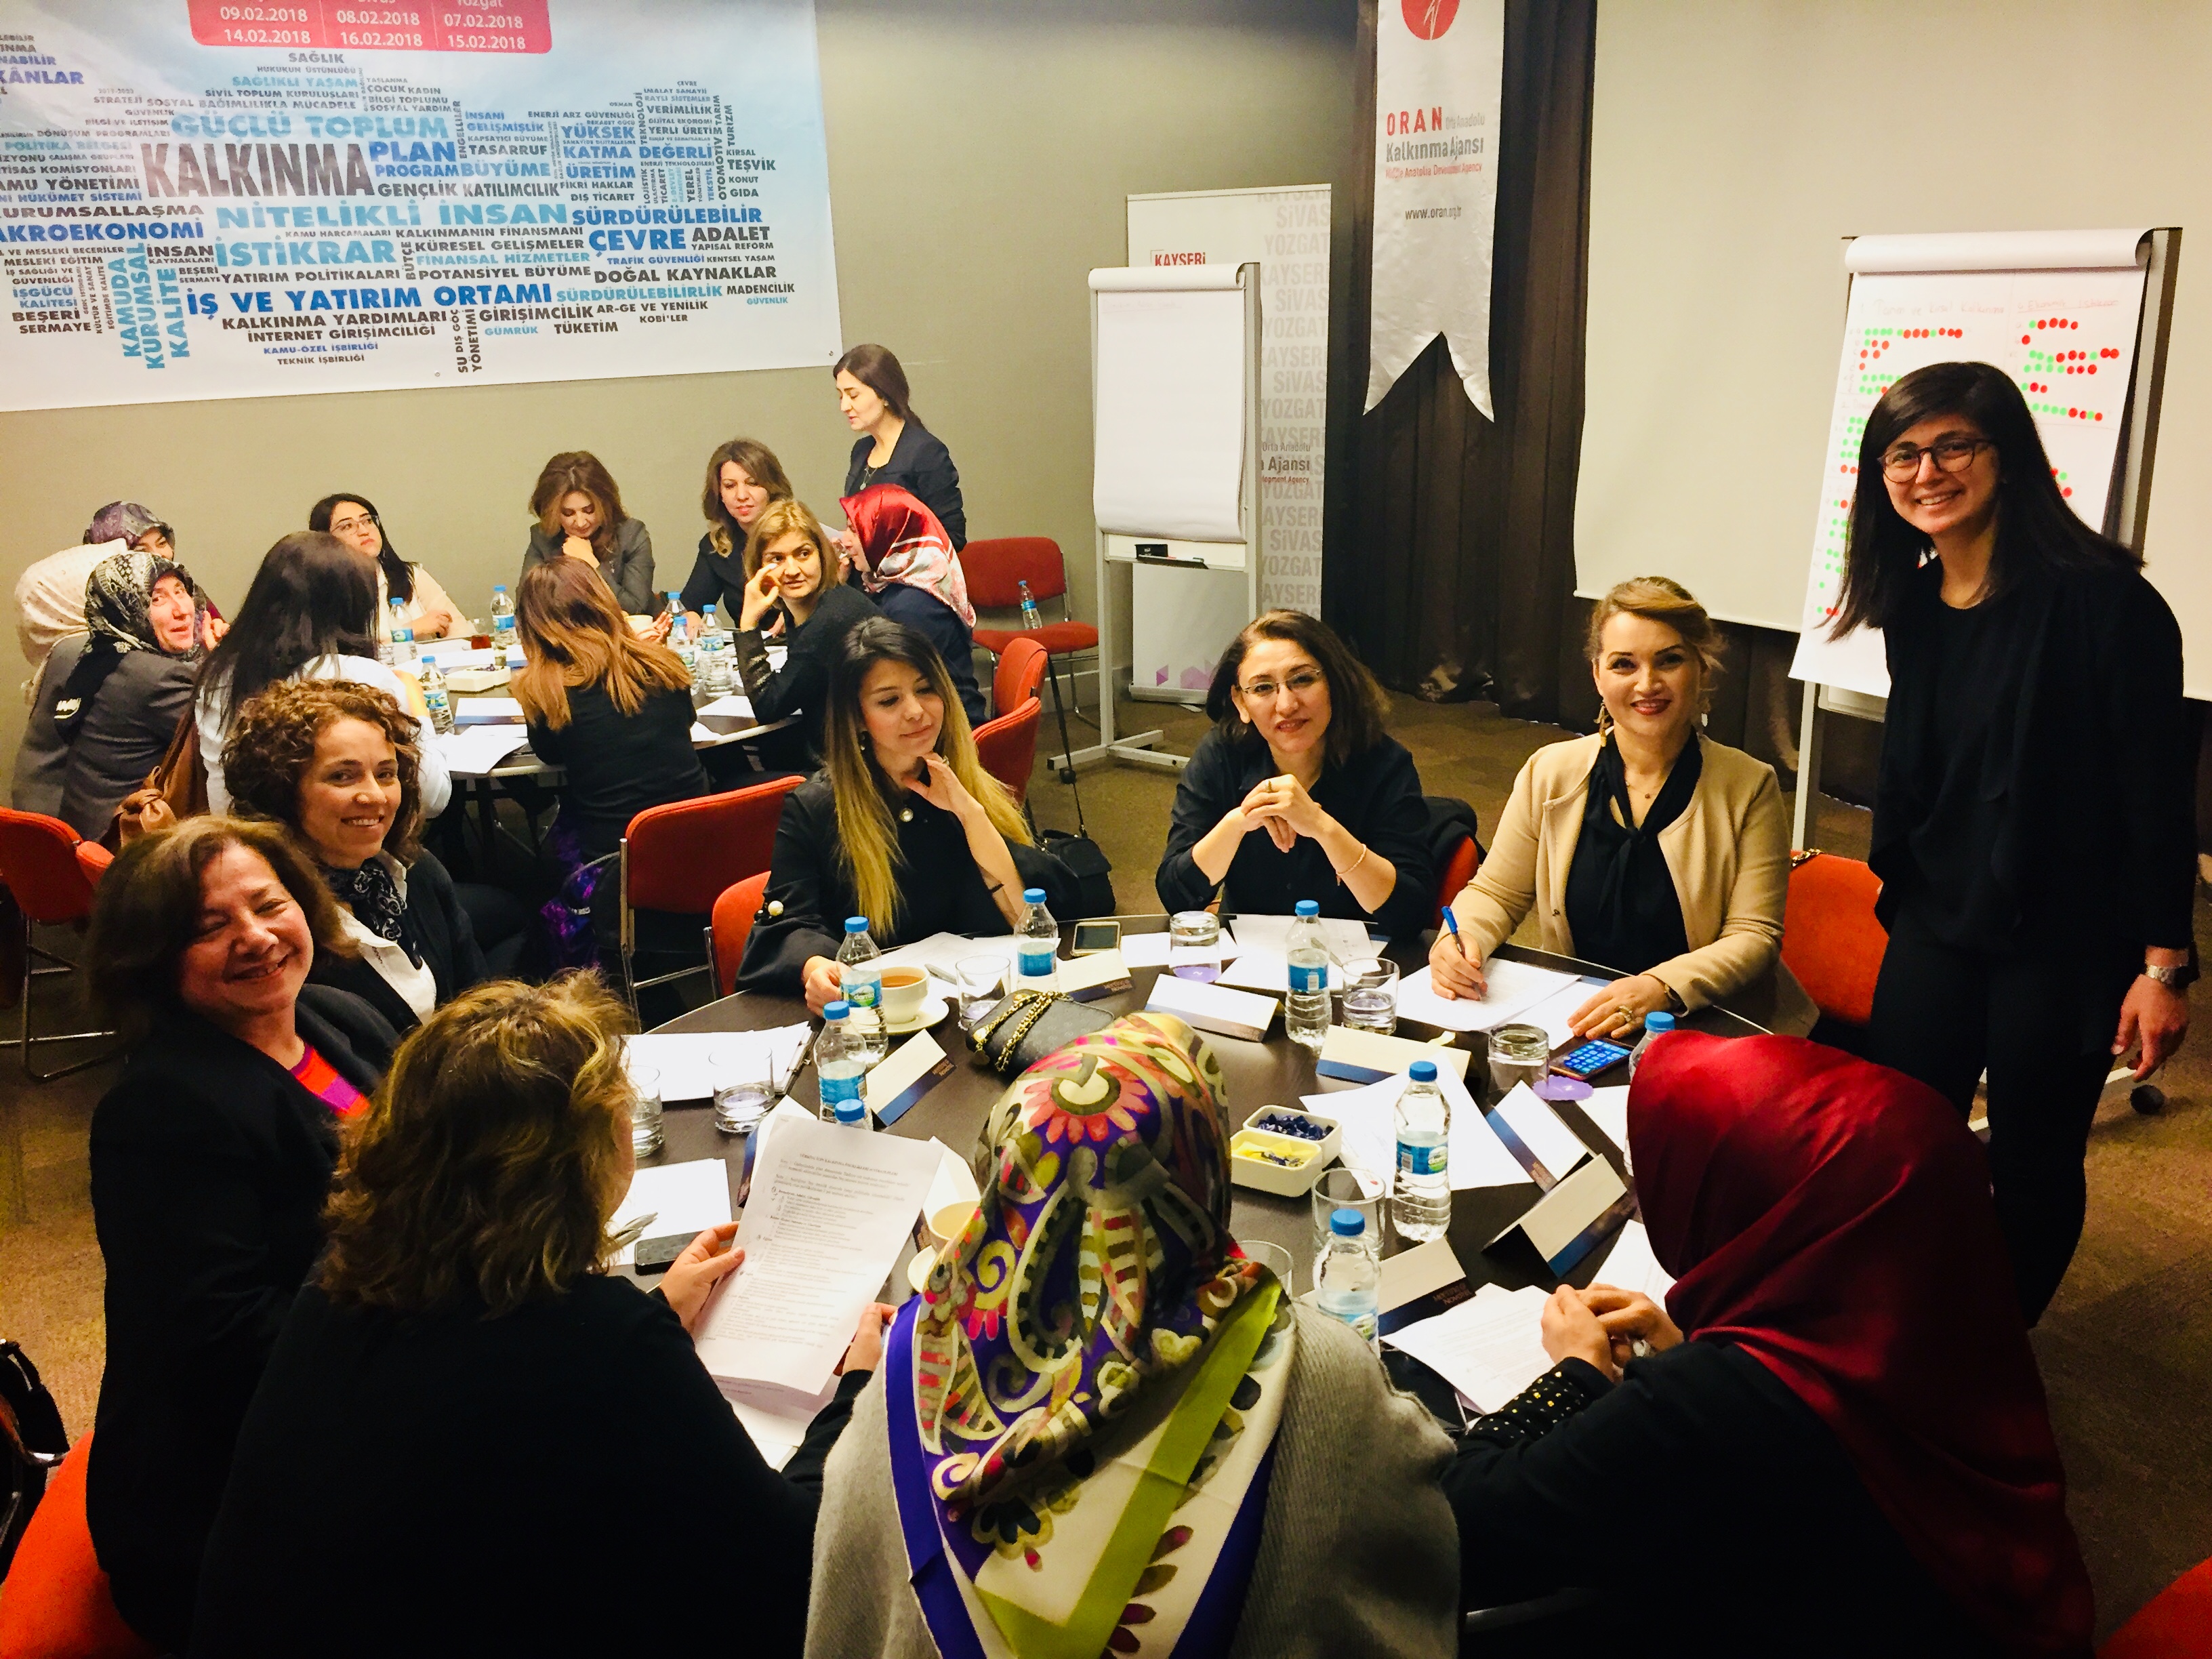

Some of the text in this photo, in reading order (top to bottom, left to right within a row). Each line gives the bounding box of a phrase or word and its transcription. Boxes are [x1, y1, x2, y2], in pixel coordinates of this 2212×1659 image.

[220, 7, 523, 28] 09.02.2018 08.02.2018 07.02.2018
[224, 28, 526, 49] 14.02.2018 16.02.2018 15.02.2018
[289, 51, 344, 63] SAĞLIK
[232, 75, 358, 89] SAĞLIKLI YAŞAM
[367, 85, 406, 94] ÇOCUK
[237, 89, 359, 99] TOPLUM KURULUŞLARI
[147, 98, 356, 108] SOSYAL MÜCADELE
[647, 104, 713, 114] VERİMLİLİK
[713, 95, 722, 125] TARIM
[634, 92, 647, 145] TEKNOLOJİ
[724, 104, 736, 146] TURİZM
[1387, 106, 1442, 136] ORAN
[171, 110, 449, 143] GÜÇLÜ TOPLUM
[467, 121, 544, 134] GELİŞMİŞLİK
[560, 123, 636, 138] YÜKSEK
[682, 125, 723, 135] ÜRETİM
[369, 141, 456, 162] PLAN
[468, 144, 548, 155] TASARRUF
[563, 143, 712, 159] KATMA DEĞERLİ
[726, 148, 756, 157] KIRSAL
[1386, 136, 1484, 163] Kalkınma Ajansı
[41, 164, 136, 173] KOMİSYONLARI
[140, 143, 374, 197] KALKINMA
[375, 164, 459, 177] PROGRAM
[461, 159, 550, 177] BÜYÜME
[566, 163, 636, 178] ÜRETİM
[712, 136, 727, 201] OTOMOTİV
[727, 157, 777, 173] TEŞVİK
[45, 176, 140, 191] YÖNETİMİ
[560, 180, 588, 188] FİKRİ
[685, 169, 695, 203] YEREL
[729, 176, 758, 184] KONUT
[18, 192, 142, 202] HÜKÜMET SİSTEMİ
[377, 179, 560, 200] GENÇLİK KATILIMCILIK
[571, 191, 635, 203] DIŞ TİCARET
[730, 187, 759, 198] GIDA
[216, 199, 762, 229] NİTELİKLİ İNSAN SÜRDÜRÜLEBİLİR
[396, 228, 495, 238] KALKINMANIN
[499, 226, 583, 237] FİNANSMANI
[589, 228, 687, 258] ÇEVRE
[692, 226, 771, 242] ADALET
[691, 242, 774, 251] YAPISAL REFORM
[1264, 232, 1330, 255] YOZGAT
[26, 247, 68, 255] MESLEKİ
[73, 246, 124, 254] BECERİLER
[147, 244, 213, 257] İNSAN
[215, 234, 584, 267] İSTİKRAR KÜRESEL GELİŞMELER
[416, 251, 775, 265] FİNANSAL HİZMETLER TRAFİK GÜVENLİĞİ KENTSEL YAŞAM
[4, 255, 103, 266] MESLEKİ EĞİTİM
[401, 241, 416, 281] BÜTÇE
[179, 265, 218, 276] BEŞERİ
[221, 268, 400, 283] YATIRIM POLİTİKALARI
[419, 265, 777, 283] POTANSİYEL BÜYÜME DOĞAL KAYNAKLAR
[85, 266, 97, 303] VE SANAT
[556, 281, 795, 302] SÜRDÜRÜLEBİLİRLİK MADENCİLİK
[12, 285, 73, 300] İŞGÜCÜ
[20, 297, 77, 308] KALİTESİ
[108, 258, 142, 357] KAMUDA
[126, 243, 165, 369] KURUMSAL
[187, 284, 552, 321] İŞ VE YATIRIM ORTAMI
[12, 308, 80, 323] BEŞERİ
[157, 268, 190, 358] KALİTE
[222, 299, 708, 329] KALKINMA YARDIMLARI GİRİŞİMCİLİK AR-GE VE YENİLİK
[640, 313, 688, 323] KOBİ'LER
[19, 323, 91, 334] SERMAYE
[248, 323, 435, 343] İNTERNET GİRİŞİMCİLİĞİ
[450, 309, 464, 352] DIŞ GÖÇ
[485, 325, 538, 336] GÜMRÜK
[554, 321, 618, 335] TÜKETİM
[264, 342, 378, 354] KAMU-ÖZEL İŞBİRLİĞİ
[462, 308, 483, 373] YÖNETİMİ
[277, 353, 365, 365] TEKNİK İŞBİRLİĞİ
[457, 356, 468, 373] SU
[1280, 442, 1311, 452] Anadolu
[1268, 456, 1309, 474] Ajansı
